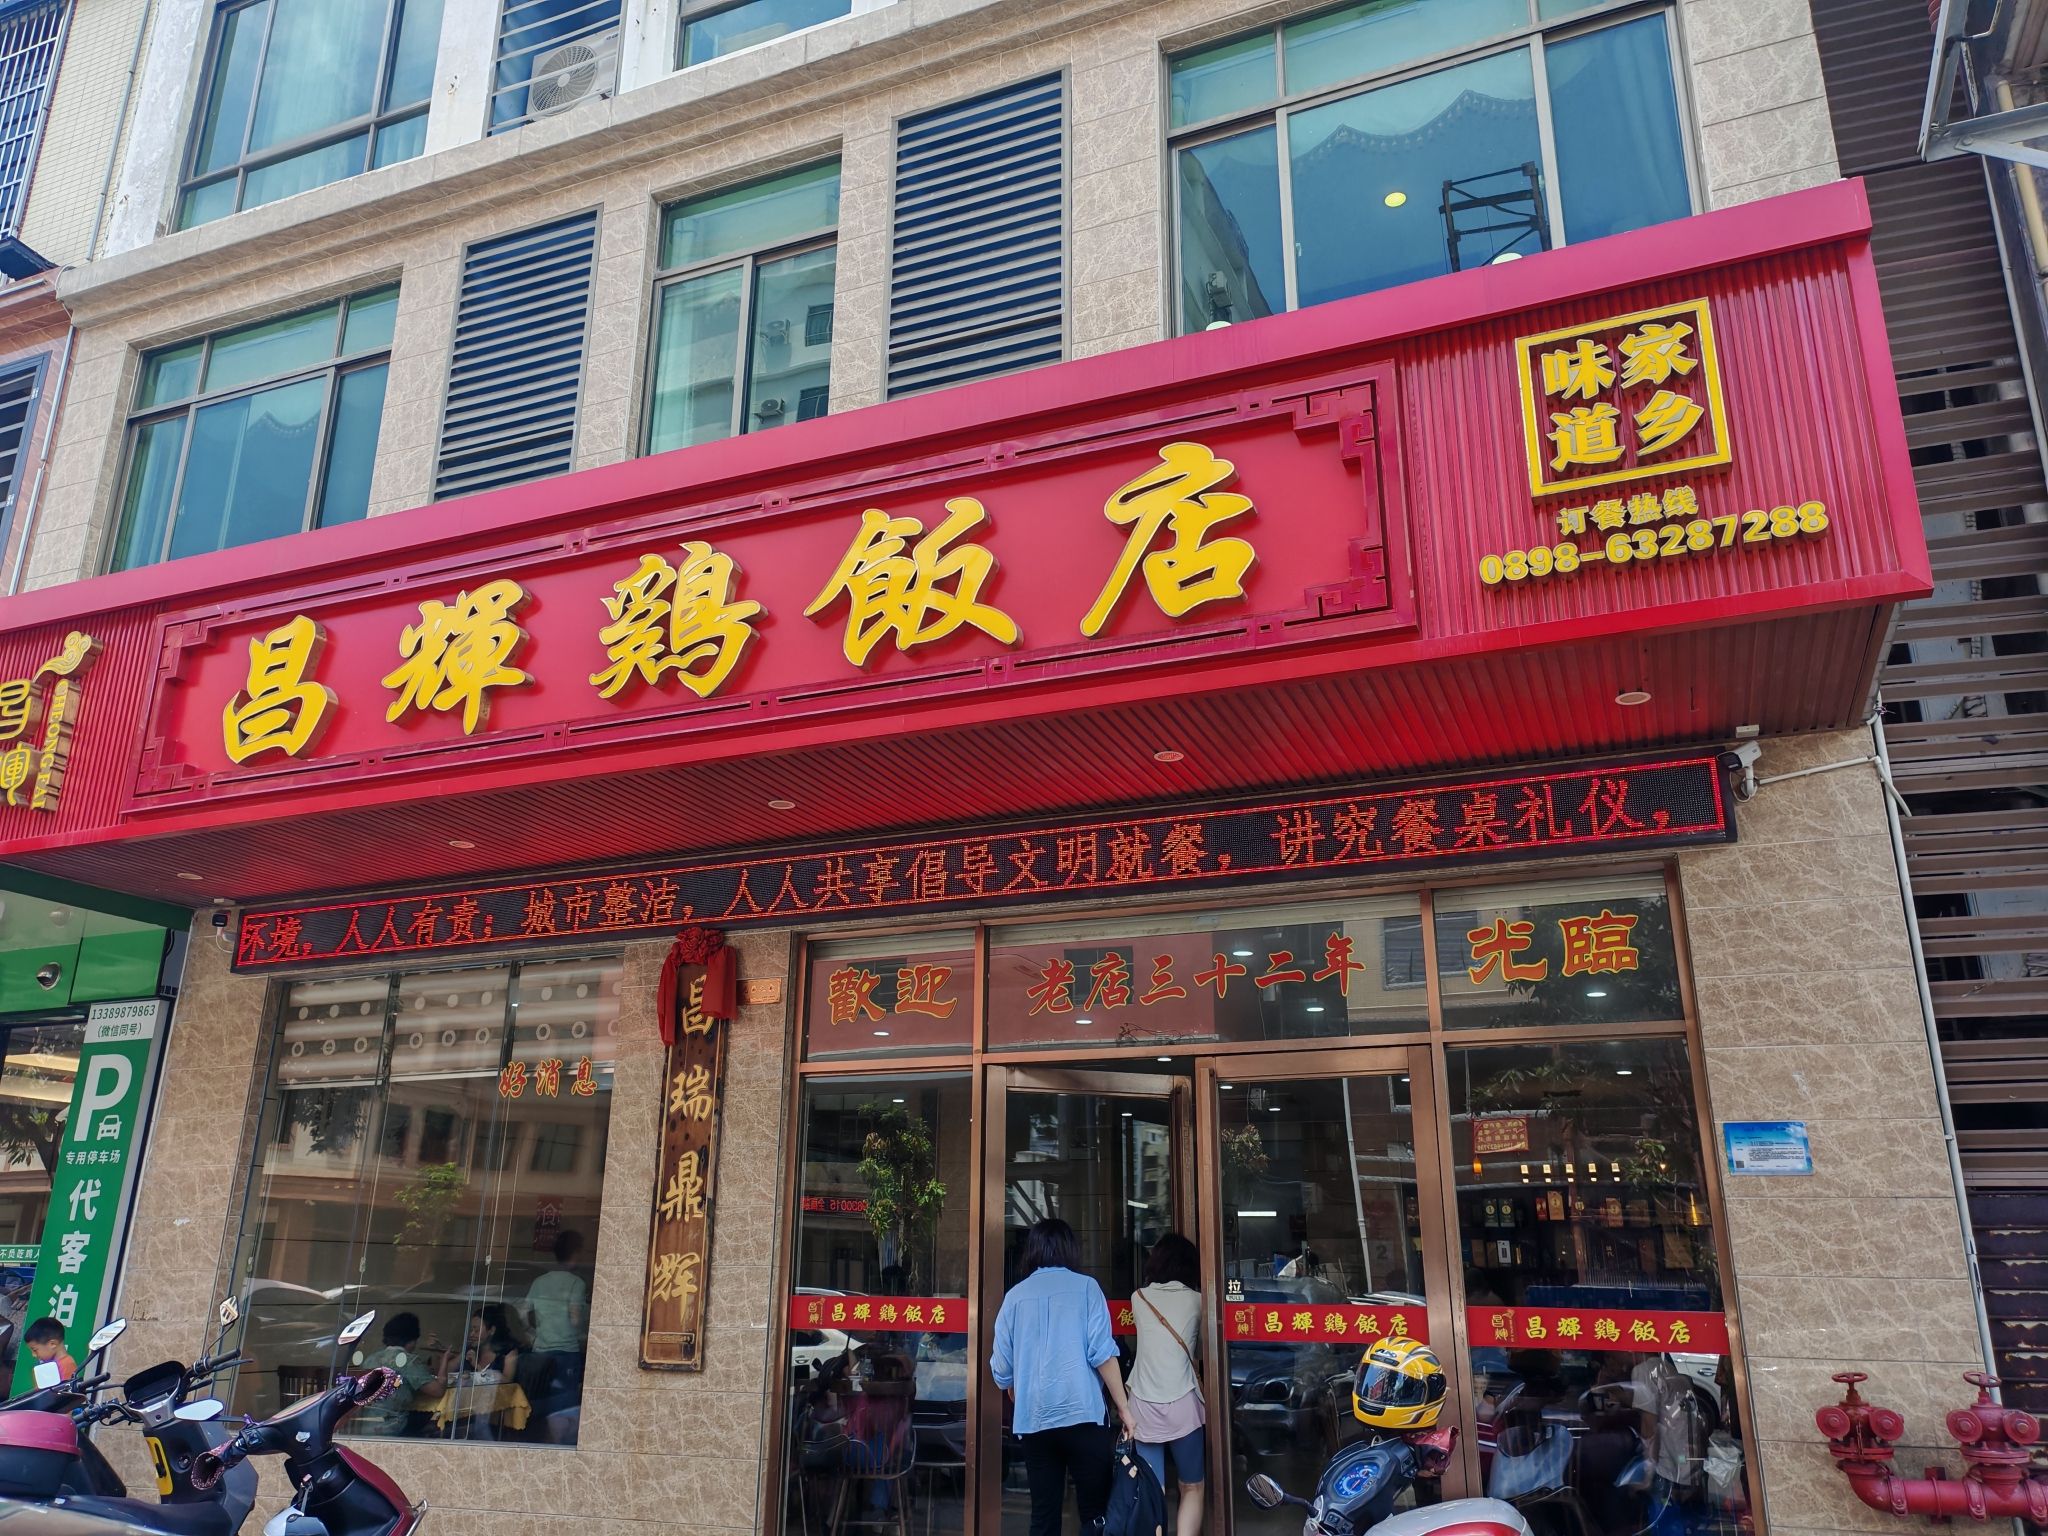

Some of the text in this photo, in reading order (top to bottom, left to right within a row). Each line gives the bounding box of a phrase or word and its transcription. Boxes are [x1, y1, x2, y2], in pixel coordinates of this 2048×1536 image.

[1556, 485, 1700, 536] 订餐热线
[1479, 500, 1830, 586] 0898-63287288
[1027, 931, 1366, 1016] 老店三十二年
[1467, 909, 1640, 986] 光臨
[91, 1004, 156, 1021] 13389879863
[828, 964, 958, 1026] 歡迎
[74, 1053, 133, 1142] P
[499, 1056, 598, 1098] 好消息
[65, 1149, 121, 1166] 专用停车场
[48, 1178, 102, 1352] 代客泊
[1228, 1279, 1242, 1294] 拉
